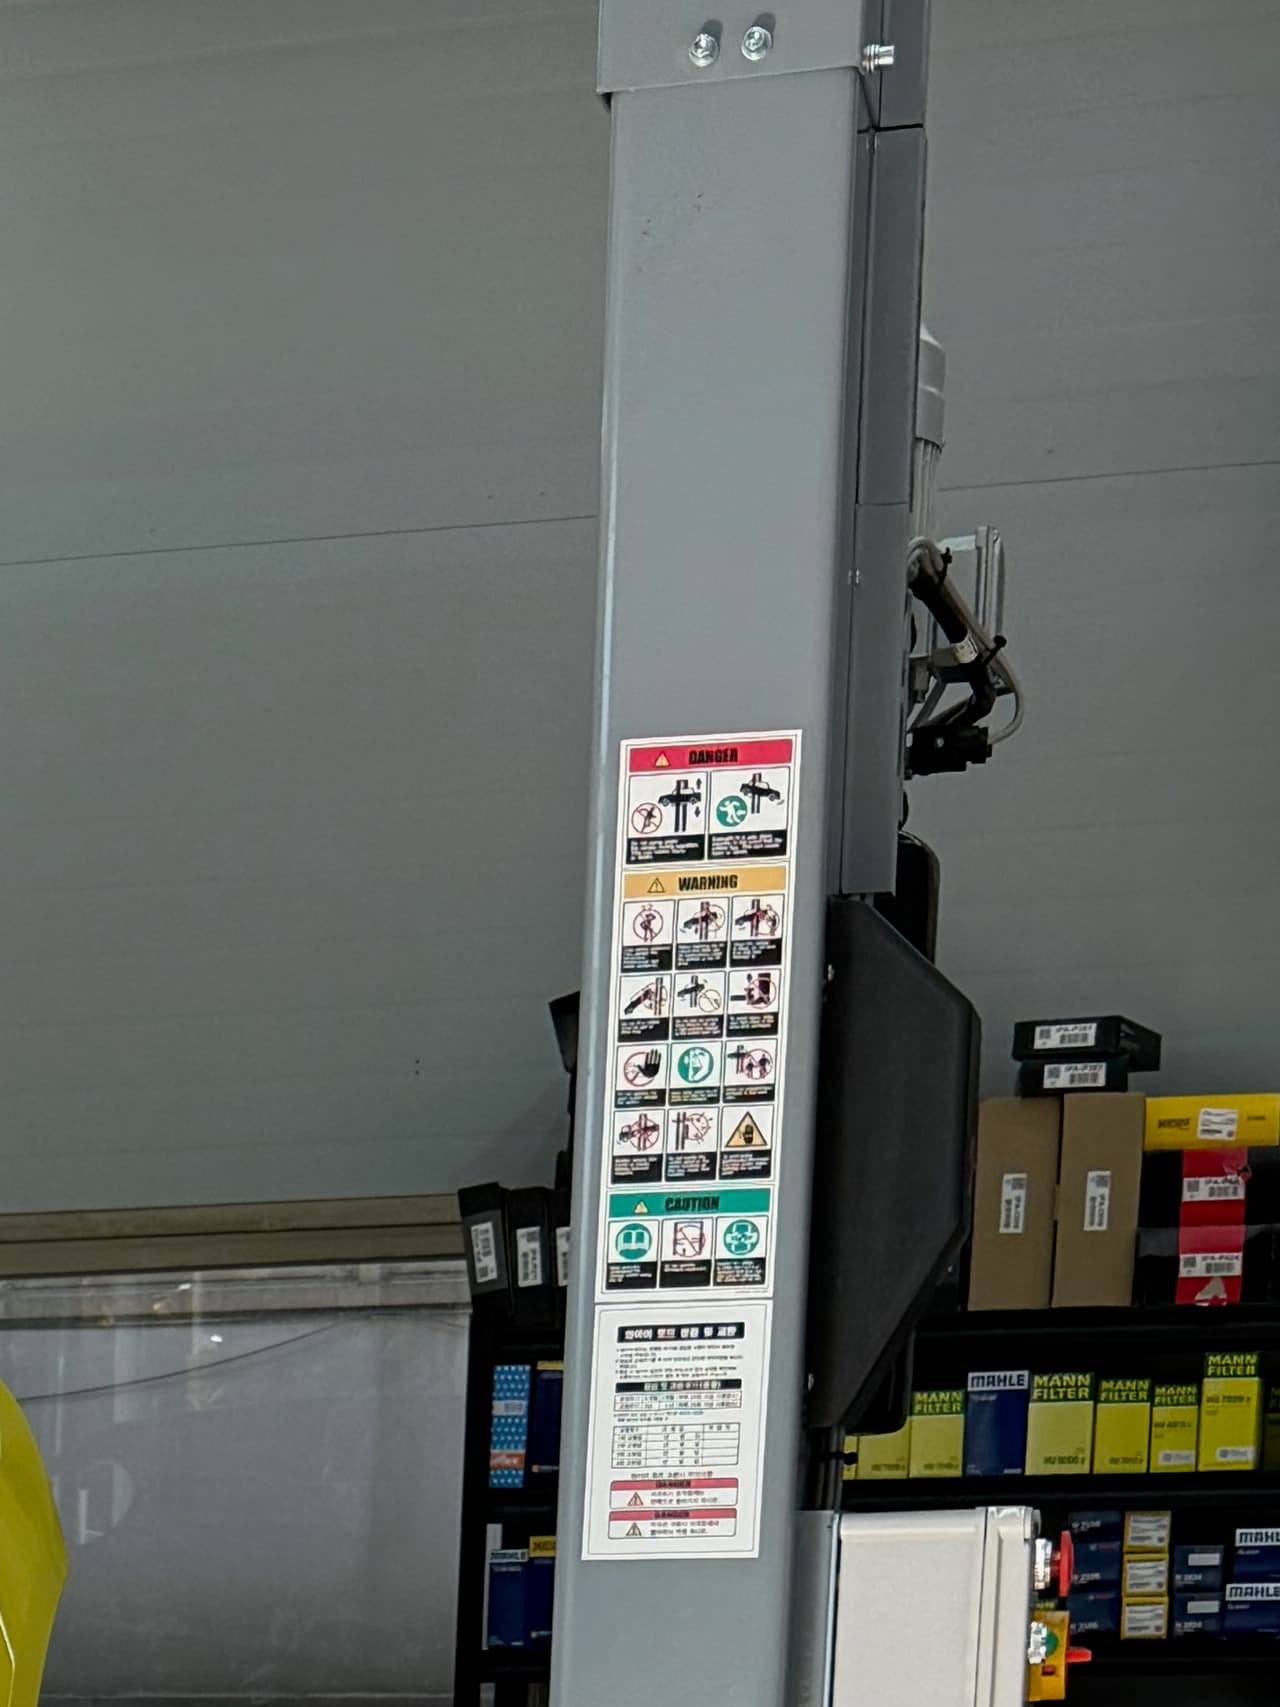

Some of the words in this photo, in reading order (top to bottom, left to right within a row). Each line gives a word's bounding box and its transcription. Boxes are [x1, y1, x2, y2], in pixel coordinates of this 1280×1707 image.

[688, 749, 738, 765] DANGER
[678, 875, 738, 891] WARNING
[665, 1196, 720, 1212] CAUTION
[1208, 1354, 1257, 1365] MANN
[1207, 1365, 1256, 1376] FILTER
[970, 1374, 1025, 1388] MAHLE
[1034, 1375, 1091, 1387] MANN
[1101, 1379, 1150, 1390] MANN
[913, 1391, 962, 1402] MANN
[1033, 1388, 1090, 1400] FILTER
[1100, 1390, 1148, 1401] FILTER
[913, 1402, 961, 1413] FILTER
